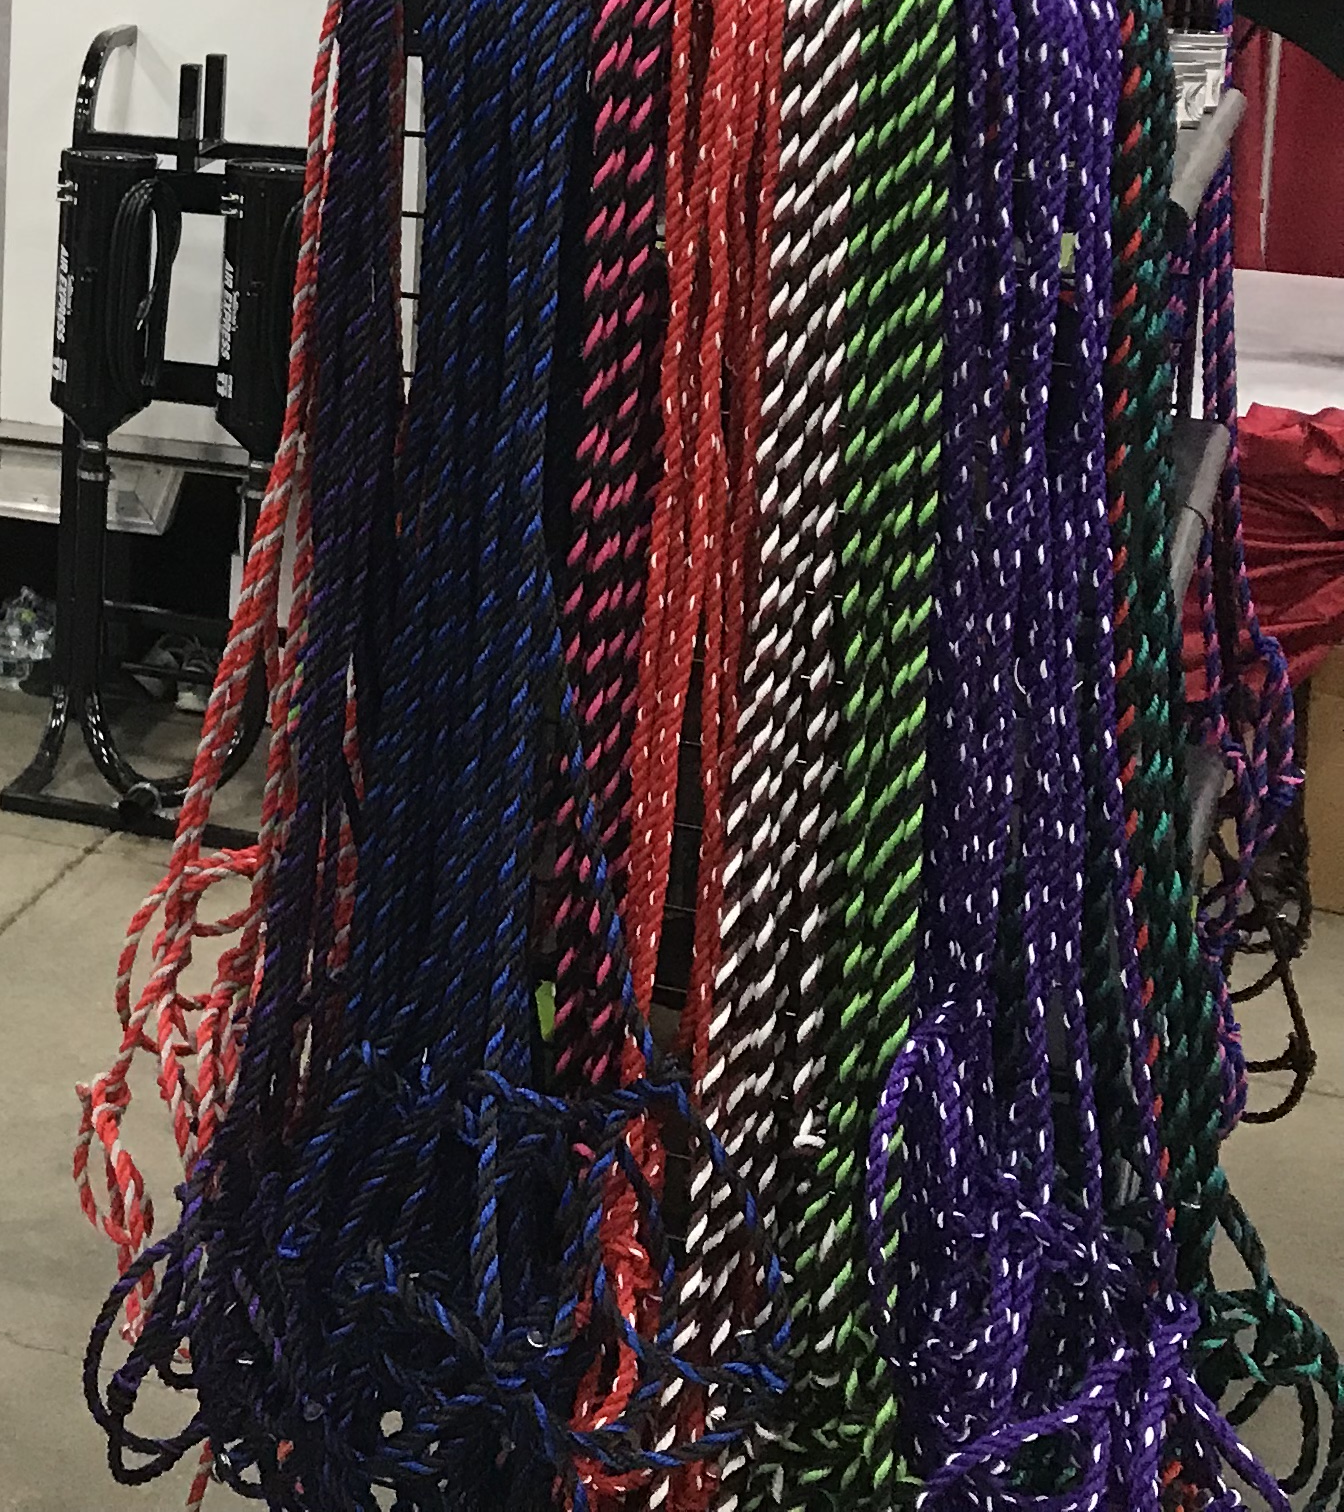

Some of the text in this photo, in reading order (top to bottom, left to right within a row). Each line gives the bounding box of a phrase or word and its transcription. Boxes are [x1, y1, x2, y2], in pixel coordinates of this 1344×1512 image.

[59, 243, 70, 274] AIR
[224, 257, 234, 289] AIR
[56, 273, 68, 344] EXPRESS
[220, 288, 233, 361] EXPRESS
